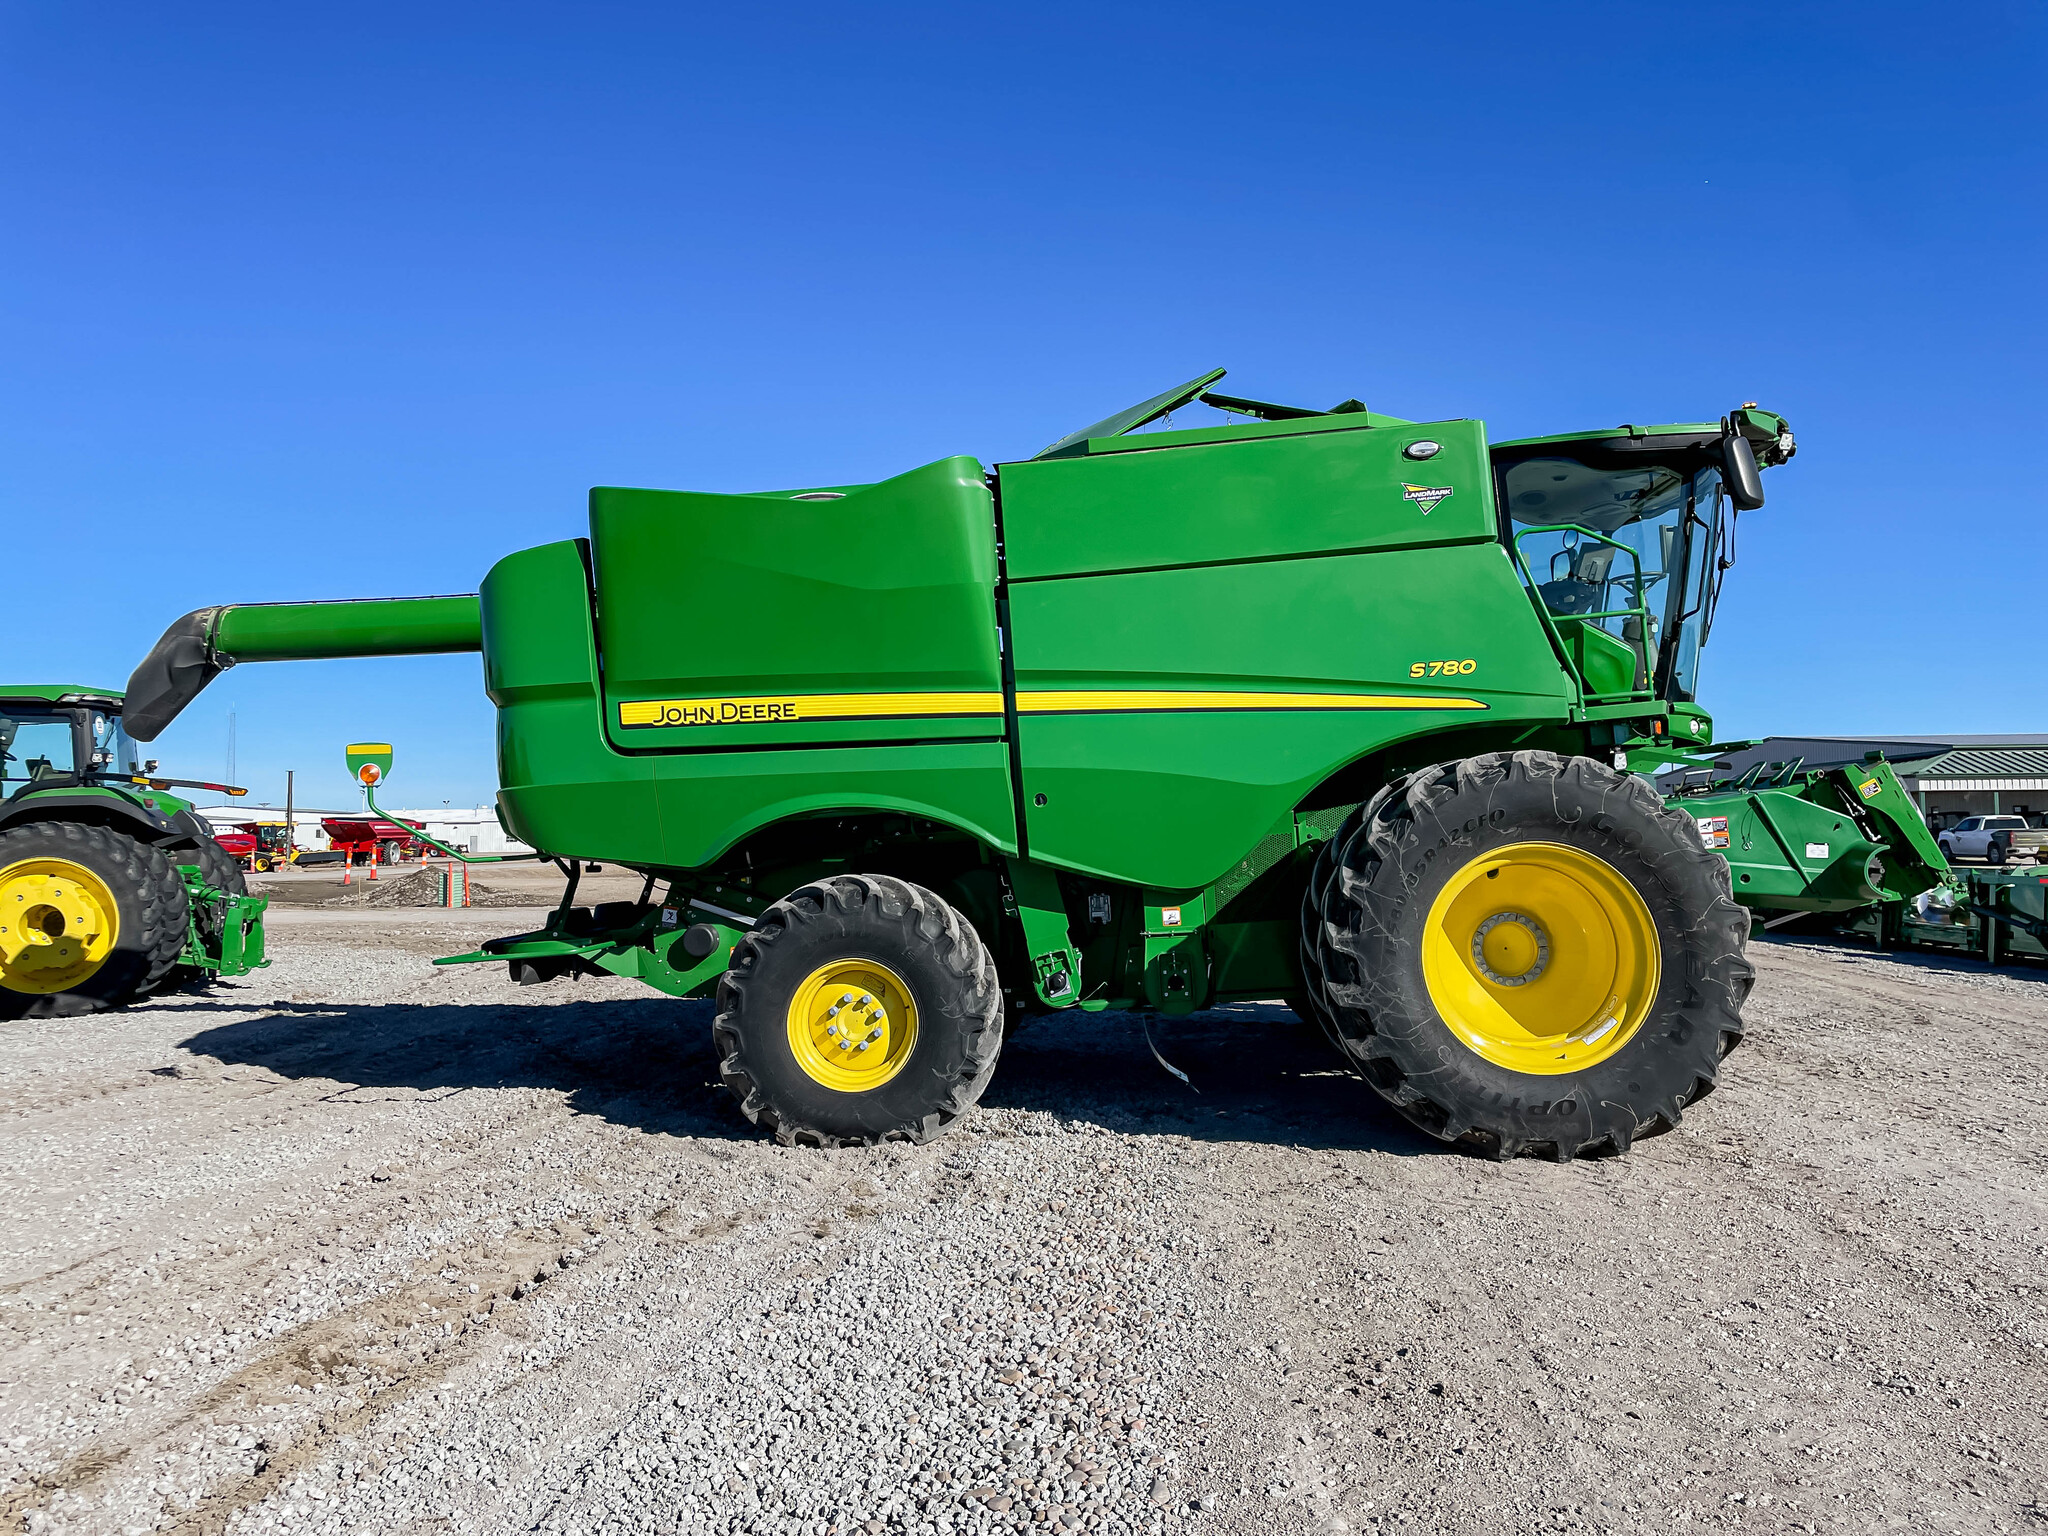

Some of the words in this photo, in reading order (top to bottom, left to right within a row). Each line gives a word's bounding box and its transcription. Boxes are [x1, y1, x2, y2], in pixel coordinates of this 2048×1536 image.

[1409, 658, 1478, 679] S780
[652, 704, 716, 724] JOHN
[720, 702, 797, 721] DEERE
